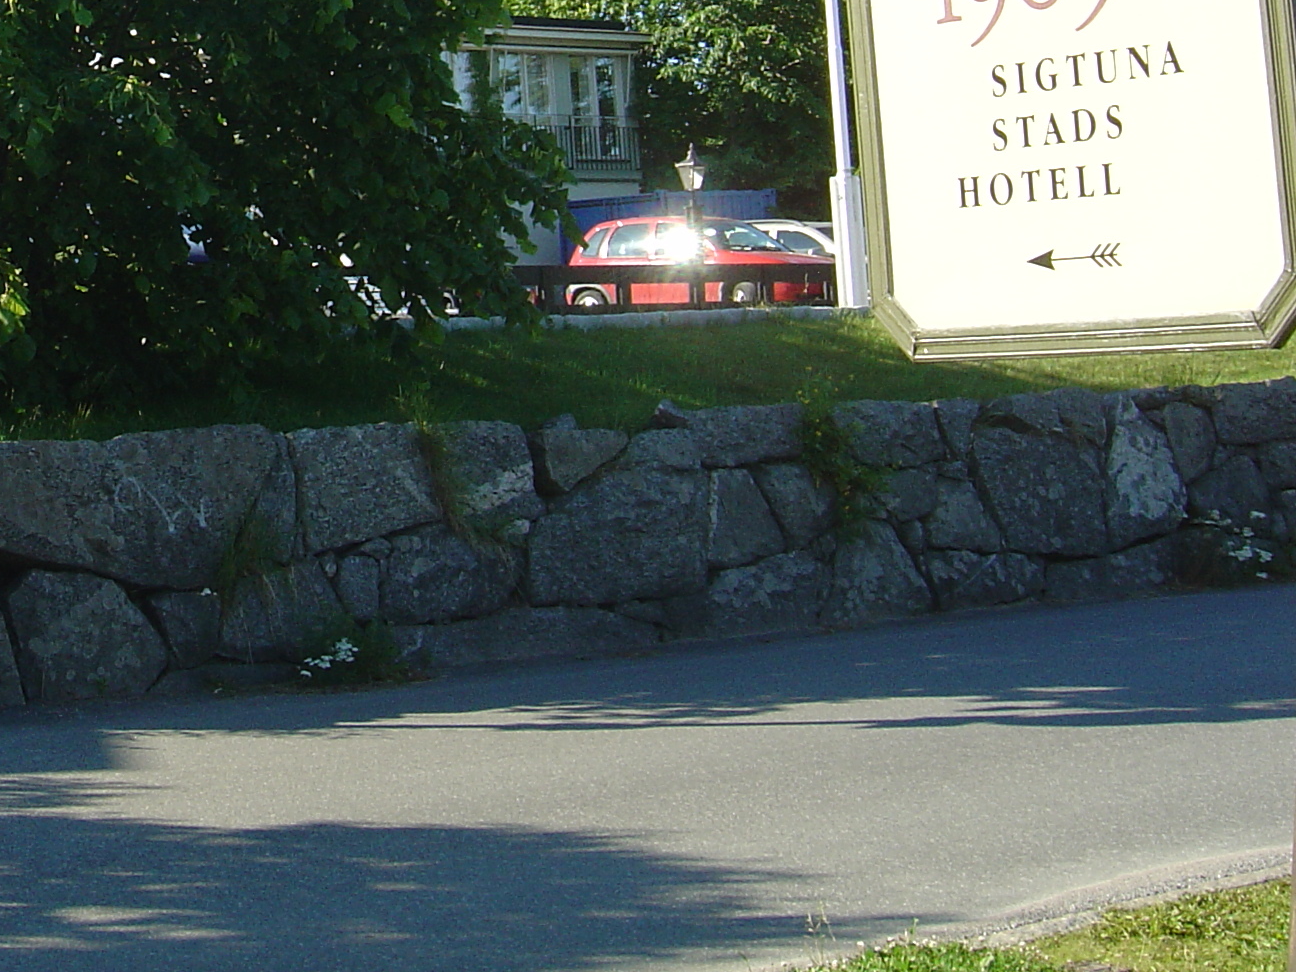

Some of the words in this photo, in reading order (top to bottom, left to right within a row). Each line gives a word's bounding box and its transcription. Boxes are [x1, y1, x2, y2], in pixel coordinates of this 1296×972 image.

[991, 40, 1185, 98] SIGTUNA
[992, 104, 1124, 152] STADS
[957, 162, 1122, 209] HOTELL
